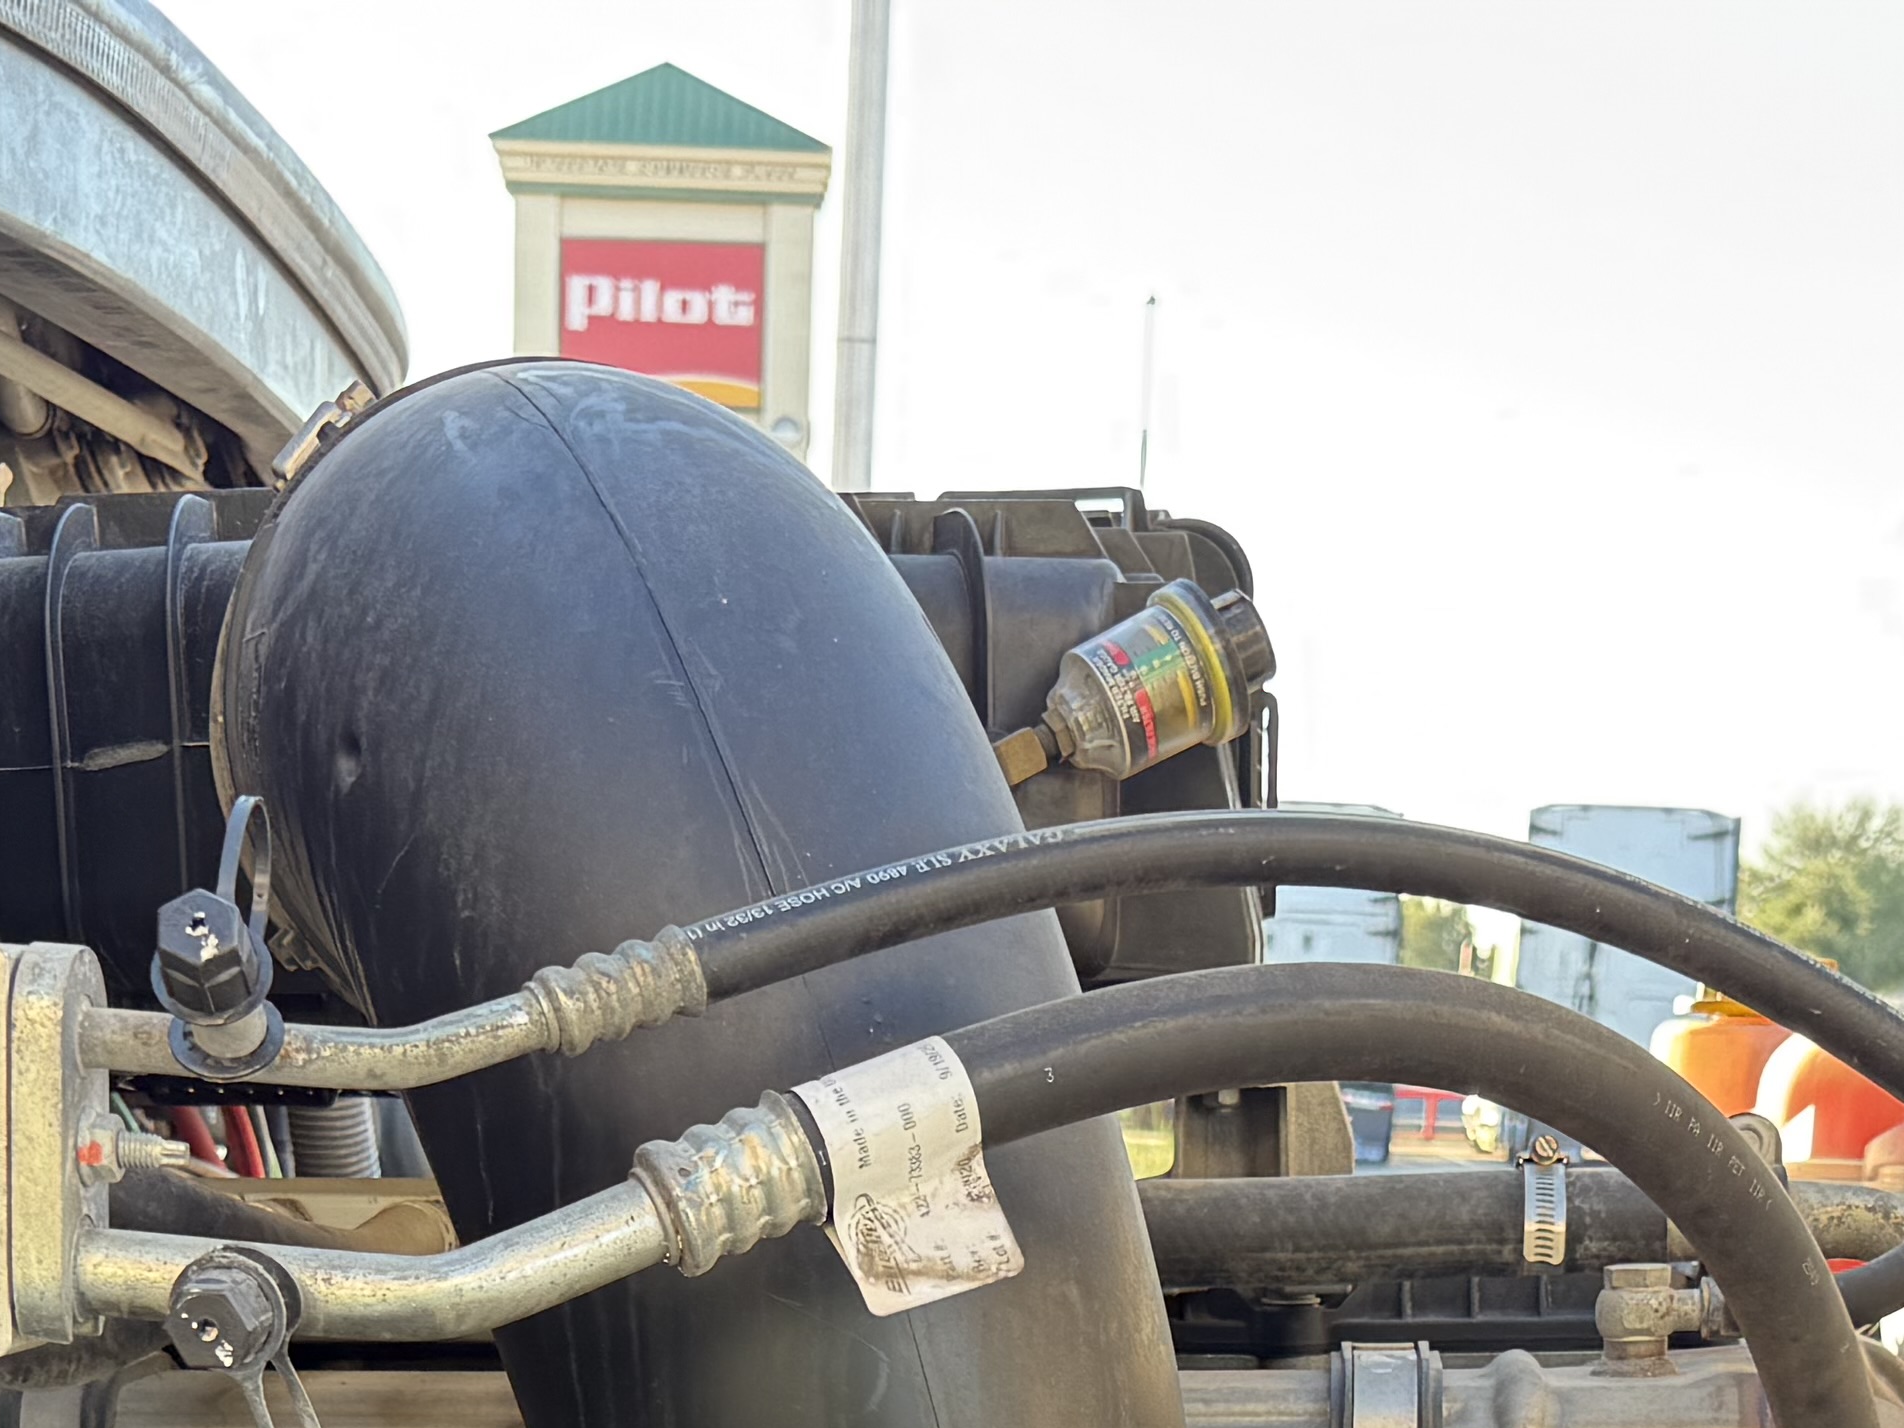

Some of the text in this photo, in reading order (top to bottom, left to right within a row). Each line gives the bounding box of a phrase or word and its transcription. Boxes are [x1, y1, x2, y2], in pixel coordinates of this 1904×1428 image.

[565, 275, 755, 331] Pilot
[958, 831, 1064, 863] GALAXY
[780, 887, 830, 912] HOSE
